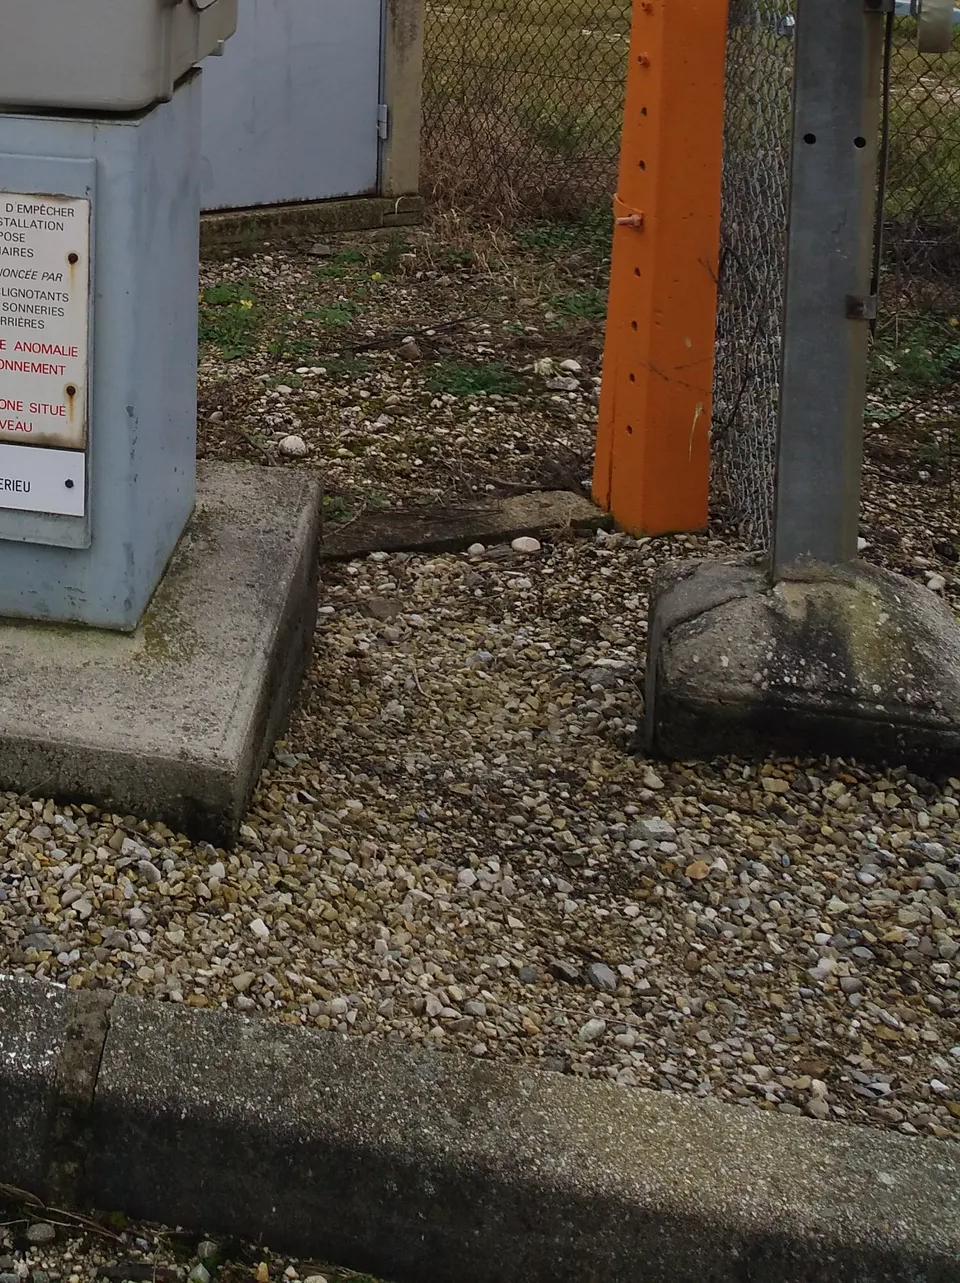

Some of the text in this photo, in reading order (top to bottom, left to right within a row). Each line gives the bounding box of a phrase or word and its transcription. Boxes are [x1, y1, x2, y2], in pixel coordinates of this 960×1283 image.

[41, 272, 63, 282] PAR
[2, 302, 65, 317] SONNERIES
[14, 341, 78, 357] ANOMALIE
